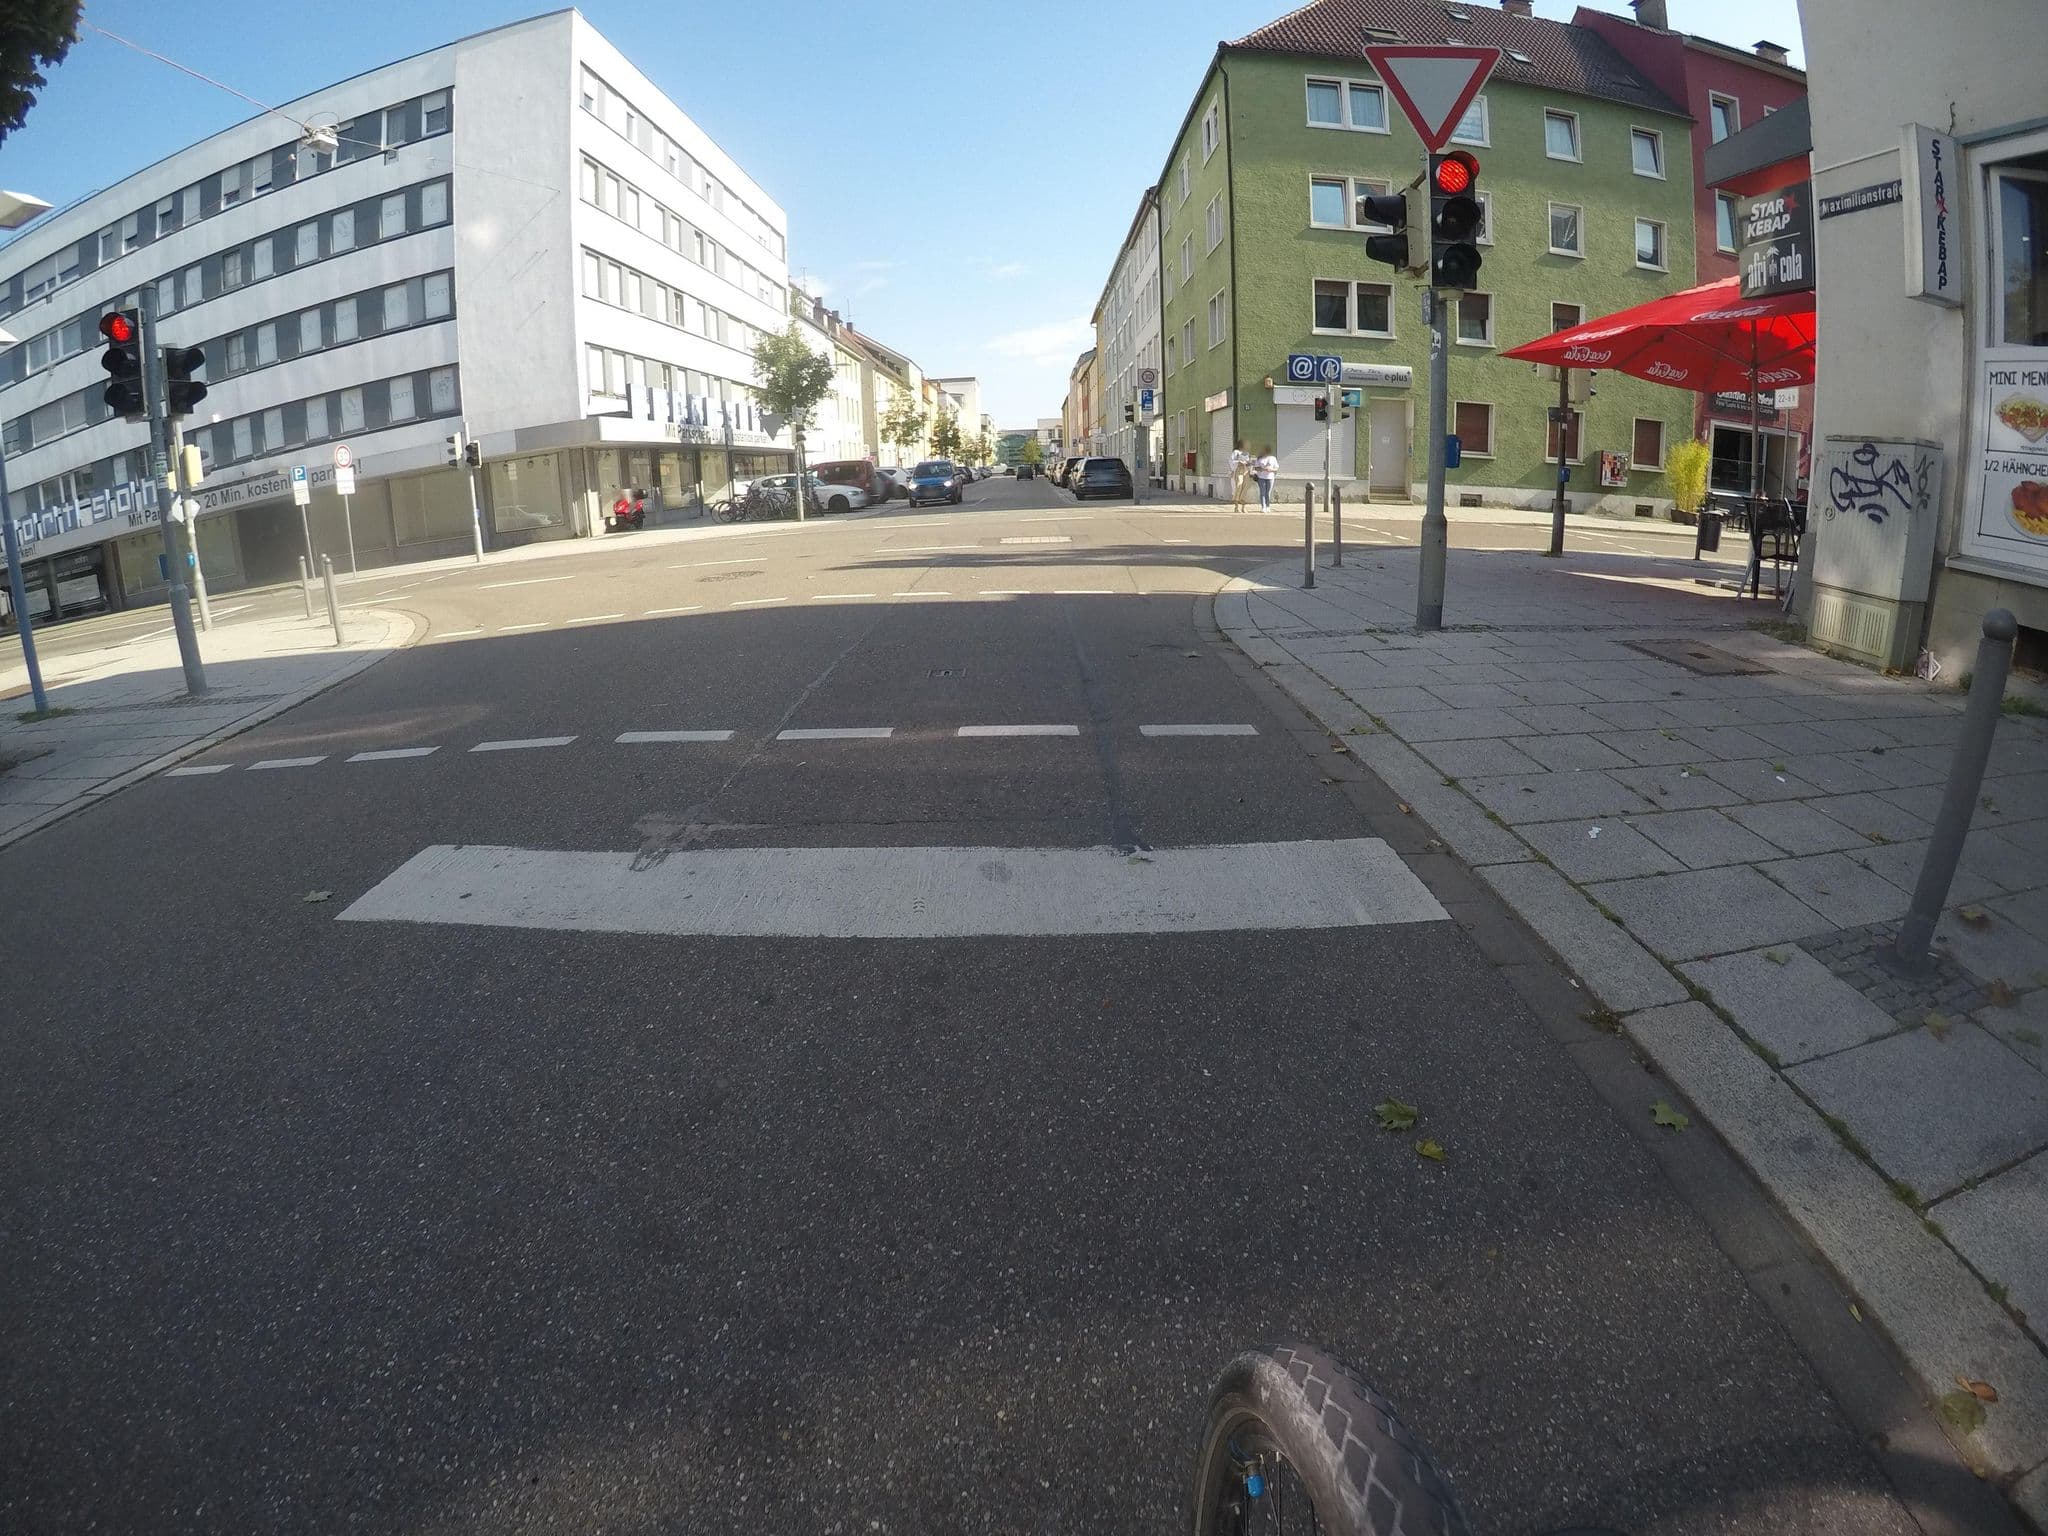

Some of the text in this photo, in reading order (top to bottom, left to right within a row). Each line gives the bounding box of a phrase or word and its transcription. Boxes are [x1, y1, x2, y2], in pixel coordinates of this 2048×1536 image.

[1751, 198, 1784, 222] STAR
[1932, 139, 1948, 290] STAR KEBAP
[1747, 214, 1791, 238] KEBAP
[1748, 243, 1803, 289] afri cola
[1989, 371, 2048, 386] MINI MEN
[294, 468, 304, 480] P
[1984, 459, 2048, 477] 1/2 HÄHNCHE
[204, 494, 218, 508] 20
[220, 488, 245, 504] Min.
[247, 475, 292, 498] kostenl
[128, 511, 142, 528] Mit
